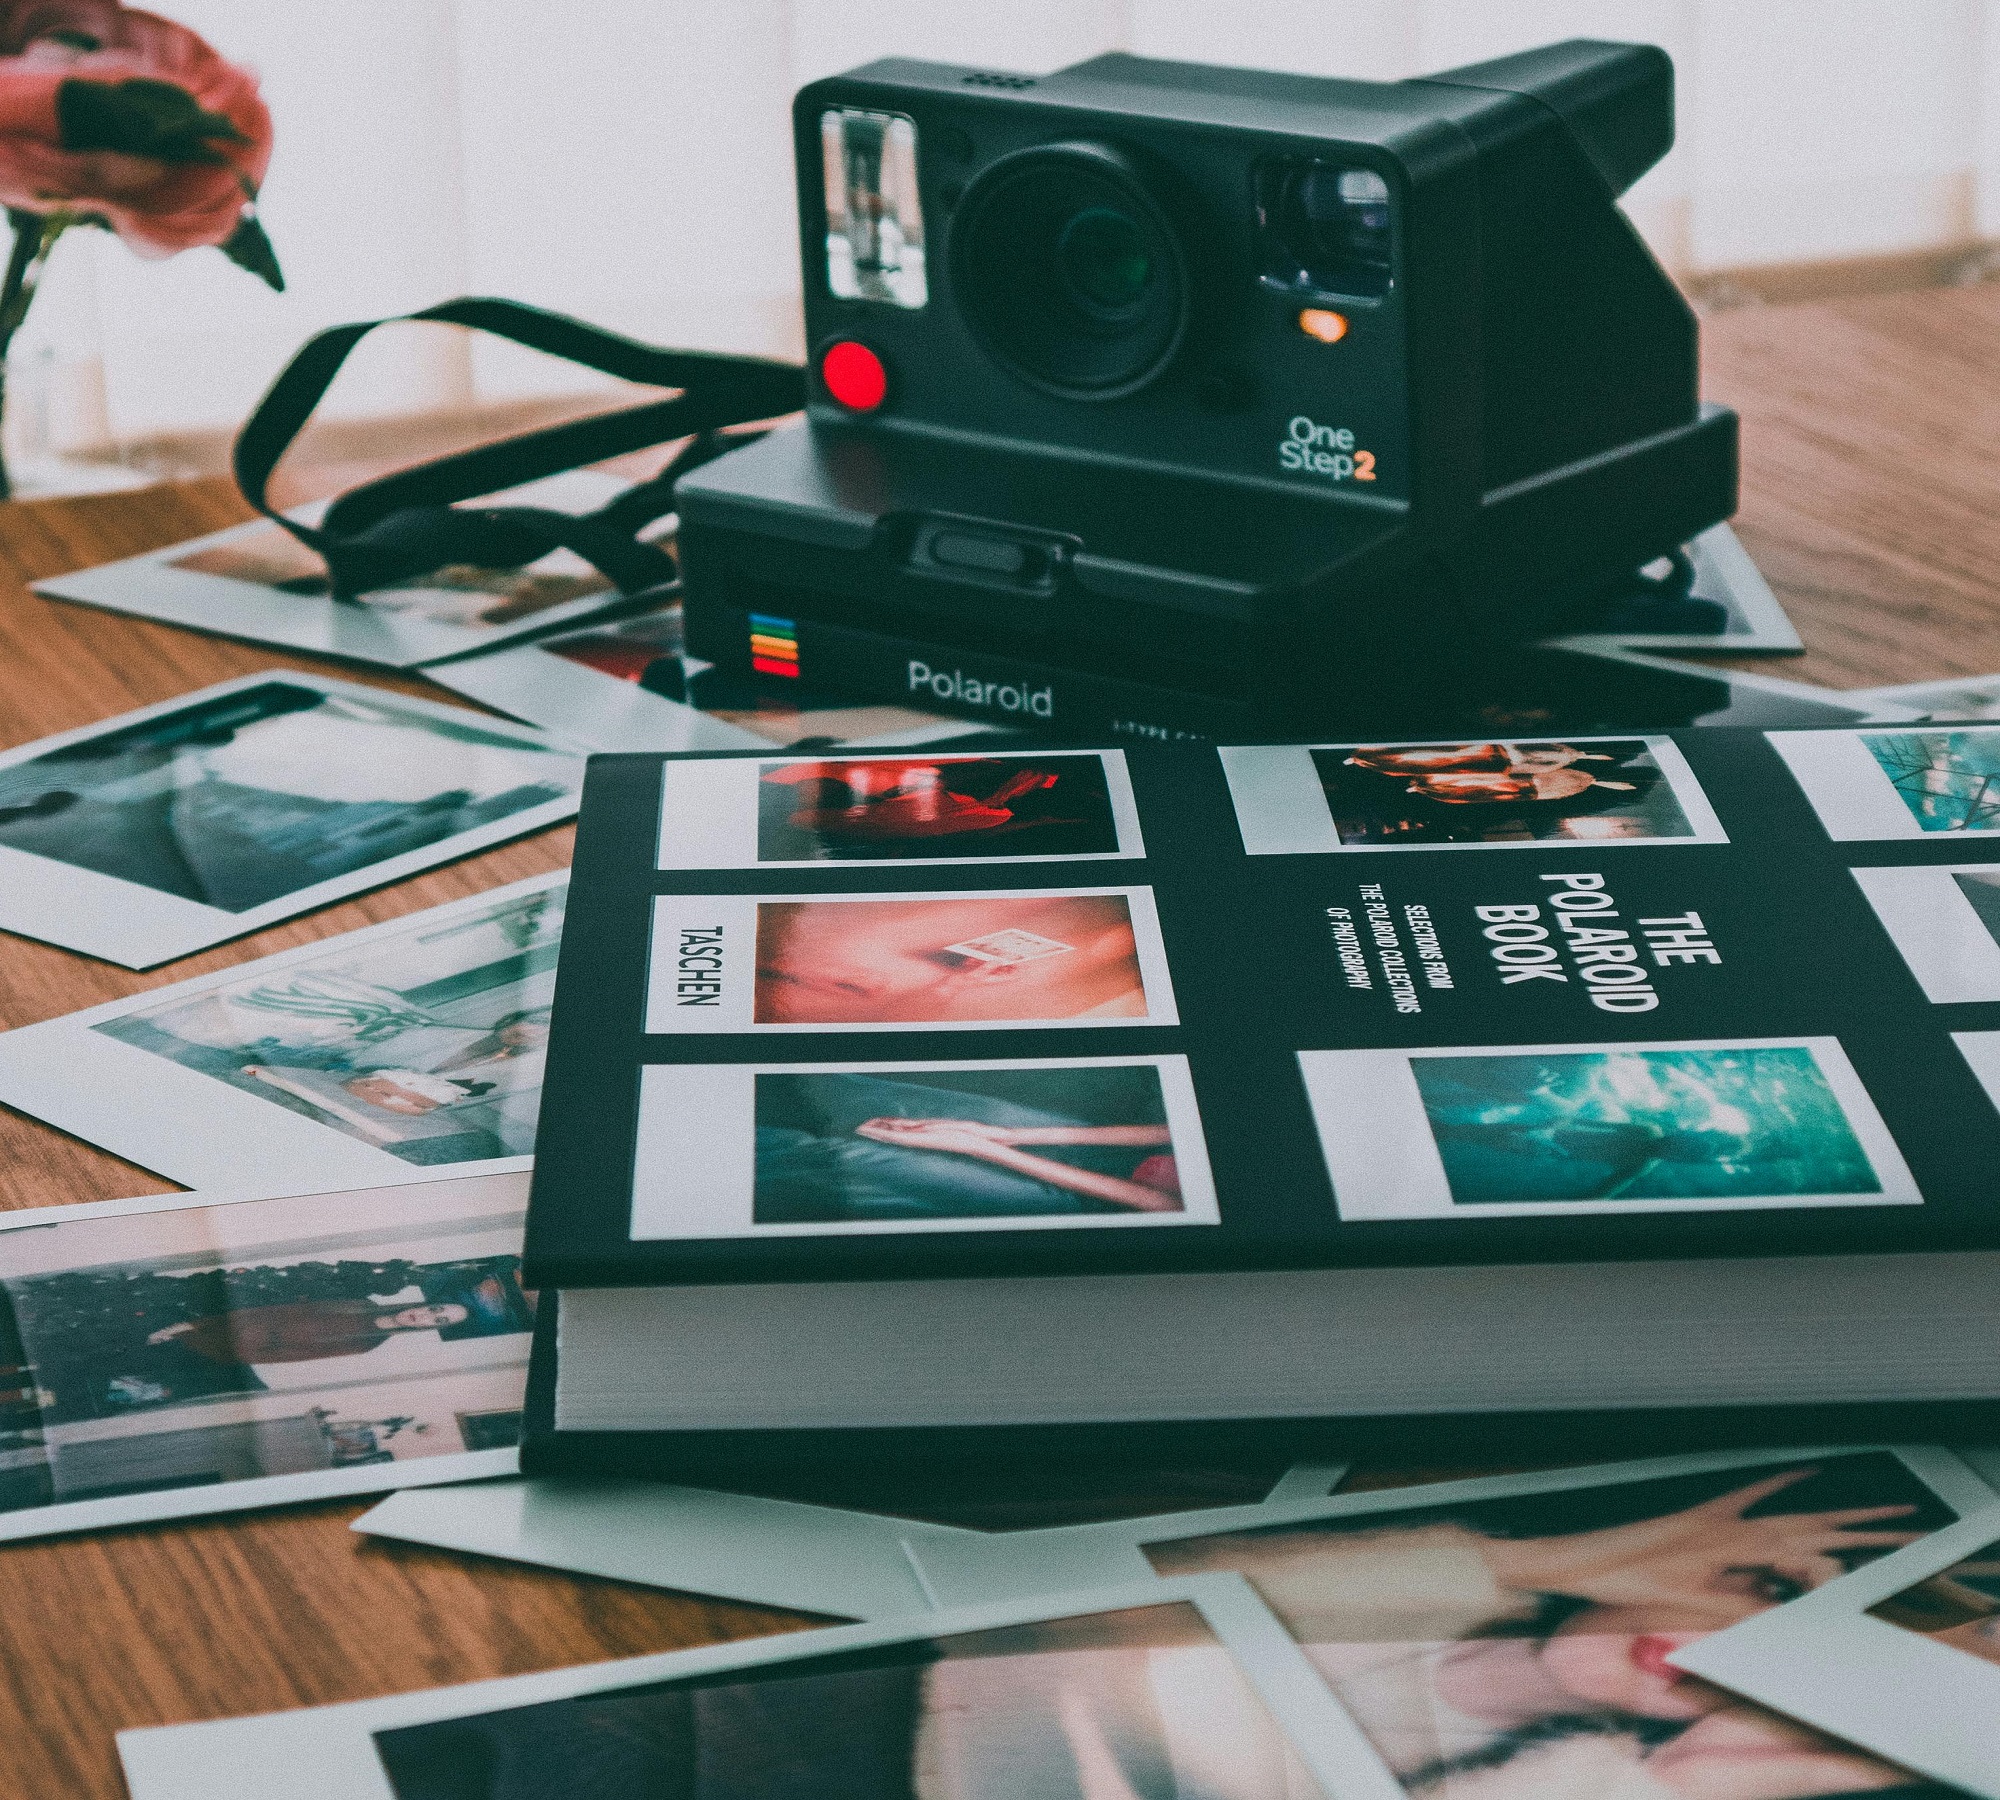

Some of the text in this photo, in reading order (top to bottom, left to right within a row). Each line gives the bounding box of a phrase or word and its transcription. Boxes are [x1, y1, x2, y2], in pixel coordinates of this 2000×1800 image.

[1289, 415, 1355, 450] One
[908, 659, 1053, 717] Polaroid
[676, 926, 724, 1006] TASCHEN
[1325, 907, 1373, 989] OF PHOTOGRAPHY
[1358, 883, 1422, 1013] THE POLAROID COLLECTIONS
[1403, 904, 1455, 989] SELECTIONS FROM
[1475, 904, 1568, 985] BOOK
[1540, 873, 1660, 1013] POLAROID
[1638, 911, 1722, 966] THE
